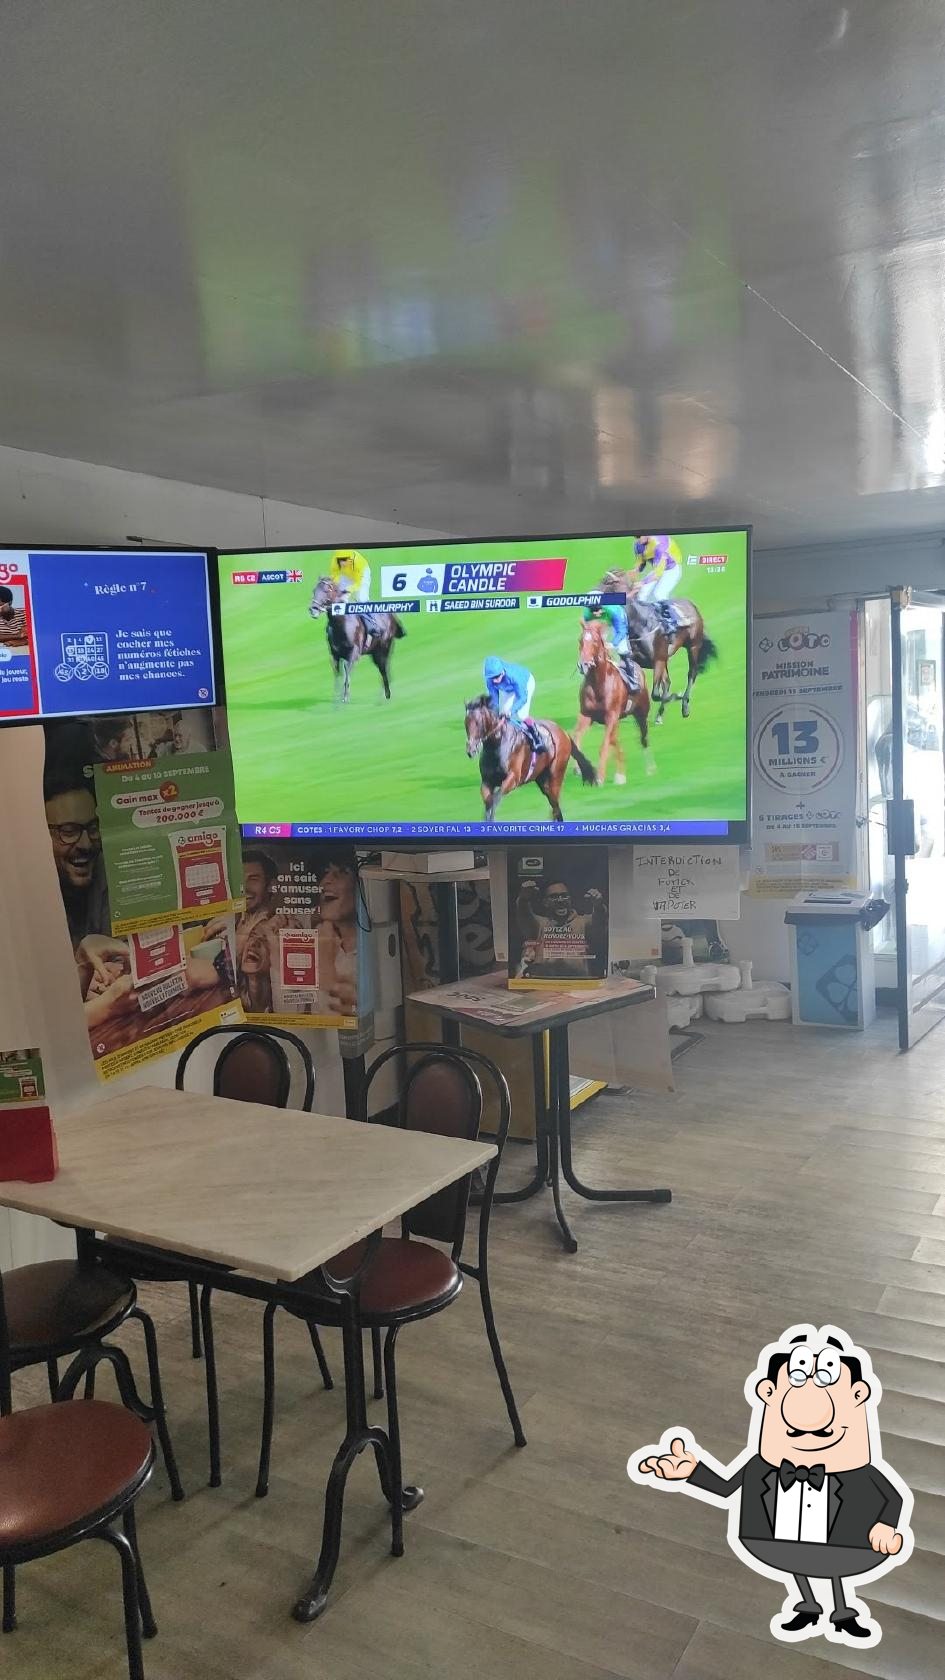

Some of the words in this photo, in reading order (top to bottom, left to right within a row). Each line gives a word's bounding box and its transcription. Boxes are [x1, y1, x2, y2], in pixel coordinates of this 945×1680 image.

[450, 562, 517, 578] OLYMPIC
[261, 573, 284, 581] ASCOT
[392, 573, 407, 592] 6
[94, 582, 126, 595] Règle
[448, 577, 507, 592] CANDLE
[444, 600, 470, 611] SAEED
[471, 599, 483, 609] BIN
[484, 597, 517, 609] SUROOR
[546, 595, 602, 607] GODOLPHIN
[348, 603, 374, 613] OISIN
[375, 602, 414, 612] MURPHY
[116, 629, 129, 638] Je
[130, 628, 151, 638] sais
[153, 629, 172, 639] que
[117, 640, 151, 648] cocher
[154, 640, 175, 648] mes
[117, 650, 161, 659] numéros
[164, 648, 202, 657] fétiches
[178, 660, 195, 669] pas
[776, 660, 814, 669] MISSION
[120, 673, 140, 681] mes
[142, 670, 185, 679] chances.
[761, 666, 830, 681] PATRIMOINE
[771, 720, 820, 755] 13
[106, 760, 152, 773] ANIMATION
[768, 756, 817, 767] MILLIONS
[163, 766, 210, 778] SEPTEMBRE
[116, 795, 137, 805] Gain
[139, 795, 159, 803] max
[255, 825, 267, 835] R4
[269, 825, 281, 835] C5
[297, 826, 323, 834] COTES
[333, 825, 365, 833] FAVORY
[487, 825, 527, 833] FAVORITE
[528, 824, 555, 832] CRIME
[582, 824, 618, 832] MUCHAS
[619, 824, 657, 832] GRACIAS
[187, 831, 218, 844] amigo
[289, 861, 305, 872] Ici
[277, 874, 292, 883] on
[293, 872, 317, 883] sait
[271, 884, 324, 894] s'amuser
[283, 896, 312, 905] sans
